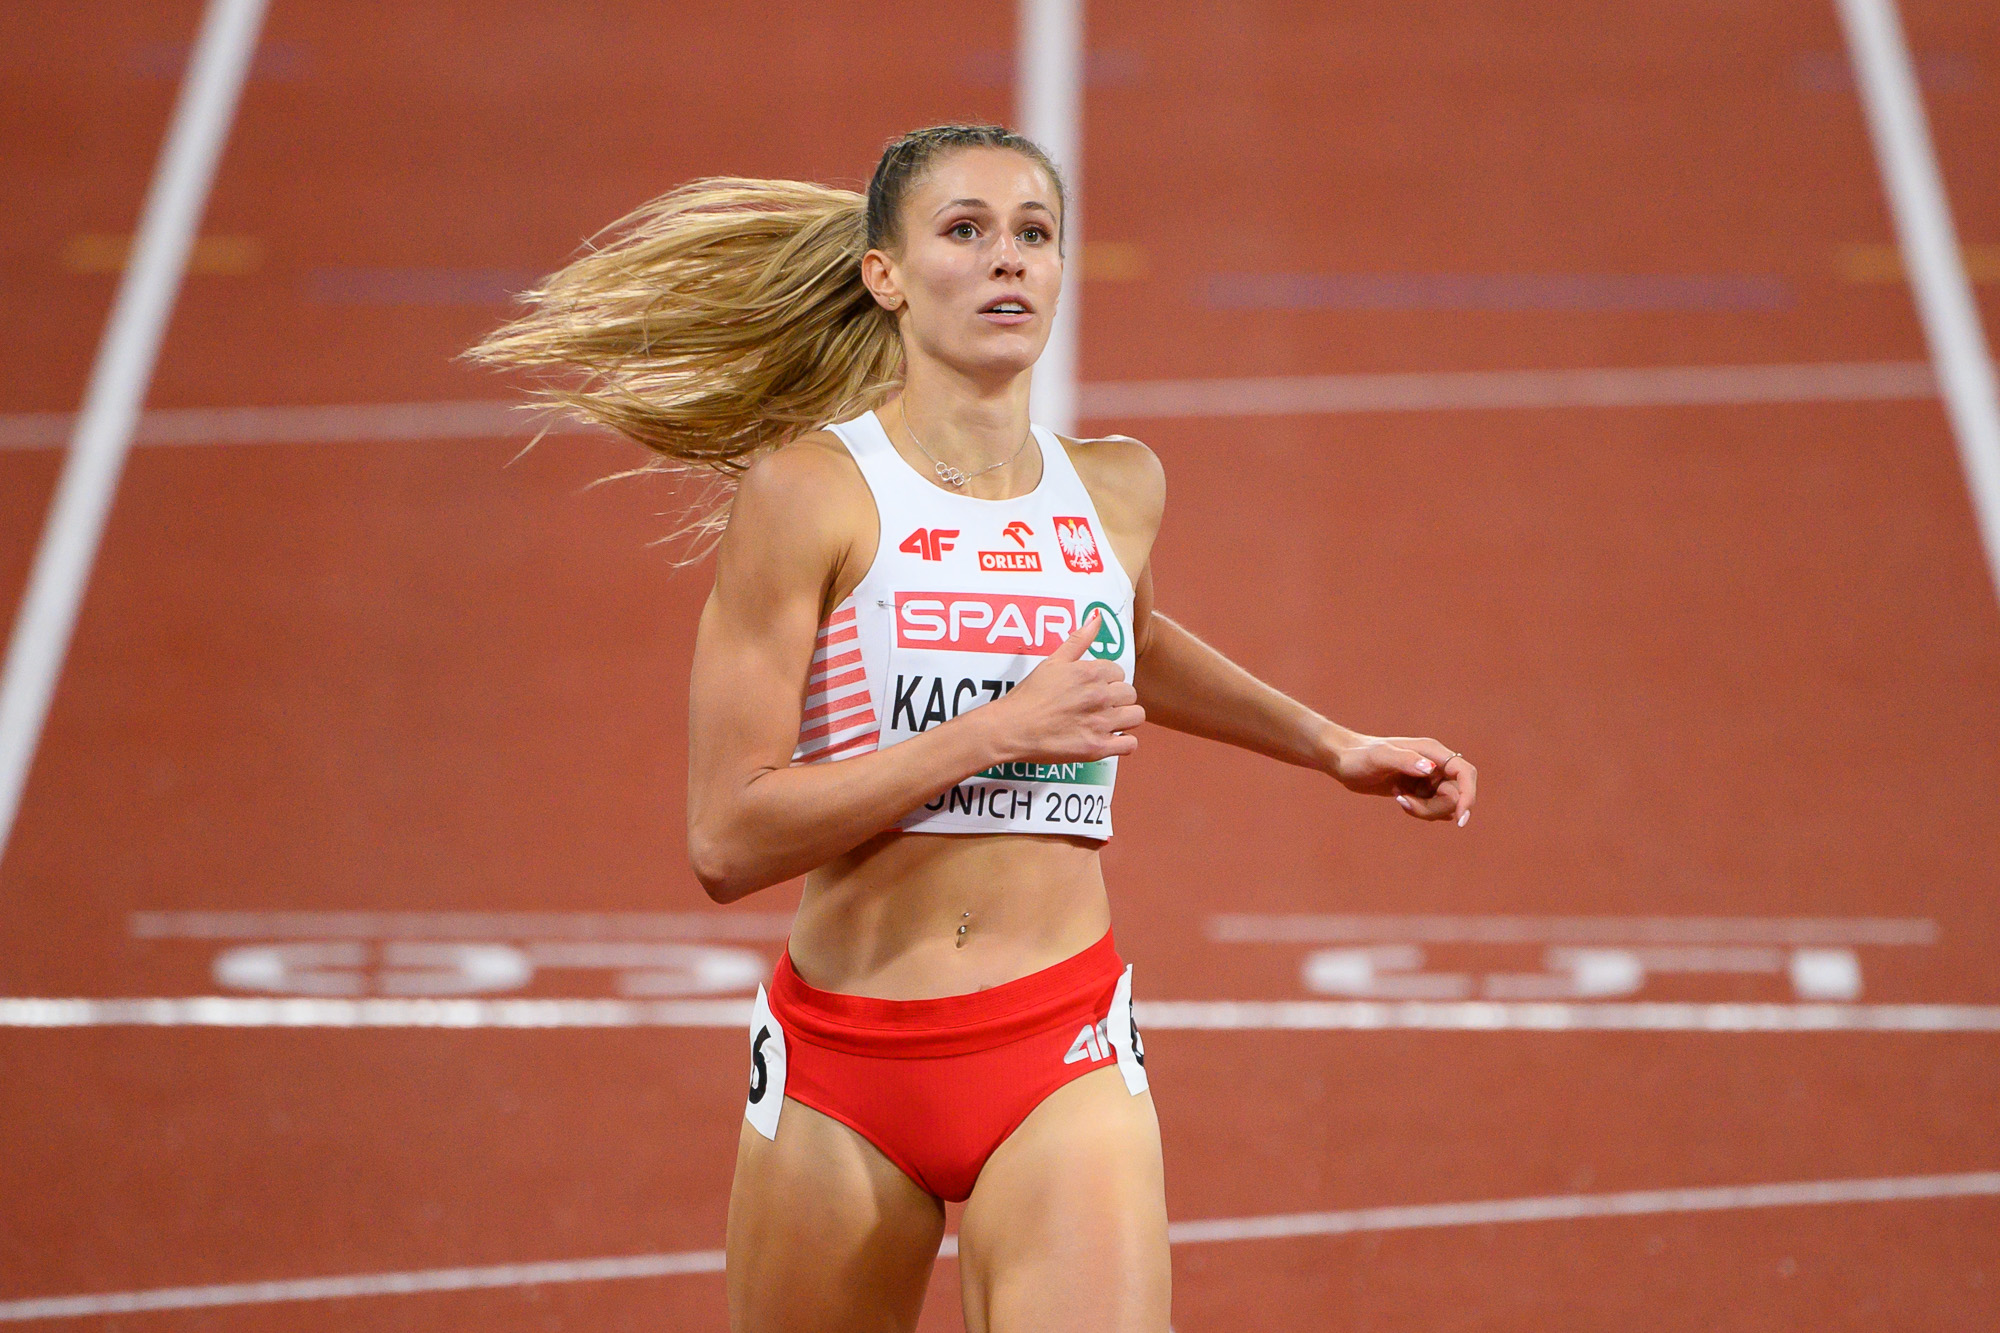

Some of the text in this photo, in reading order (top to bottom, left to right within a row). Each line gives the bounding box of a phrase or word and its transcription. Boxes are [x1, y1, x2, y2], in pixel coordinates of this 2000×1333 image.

[899, 527, 960, 561] 4F
[982, 553, 1038, 570] ORLEN
[901, 599, 1073, 646] SPAR
[891, 674, 1015, 732] KAC
[1046, 792, 1104, 825] 2022
[748, 1025, 771, 1104] 6
